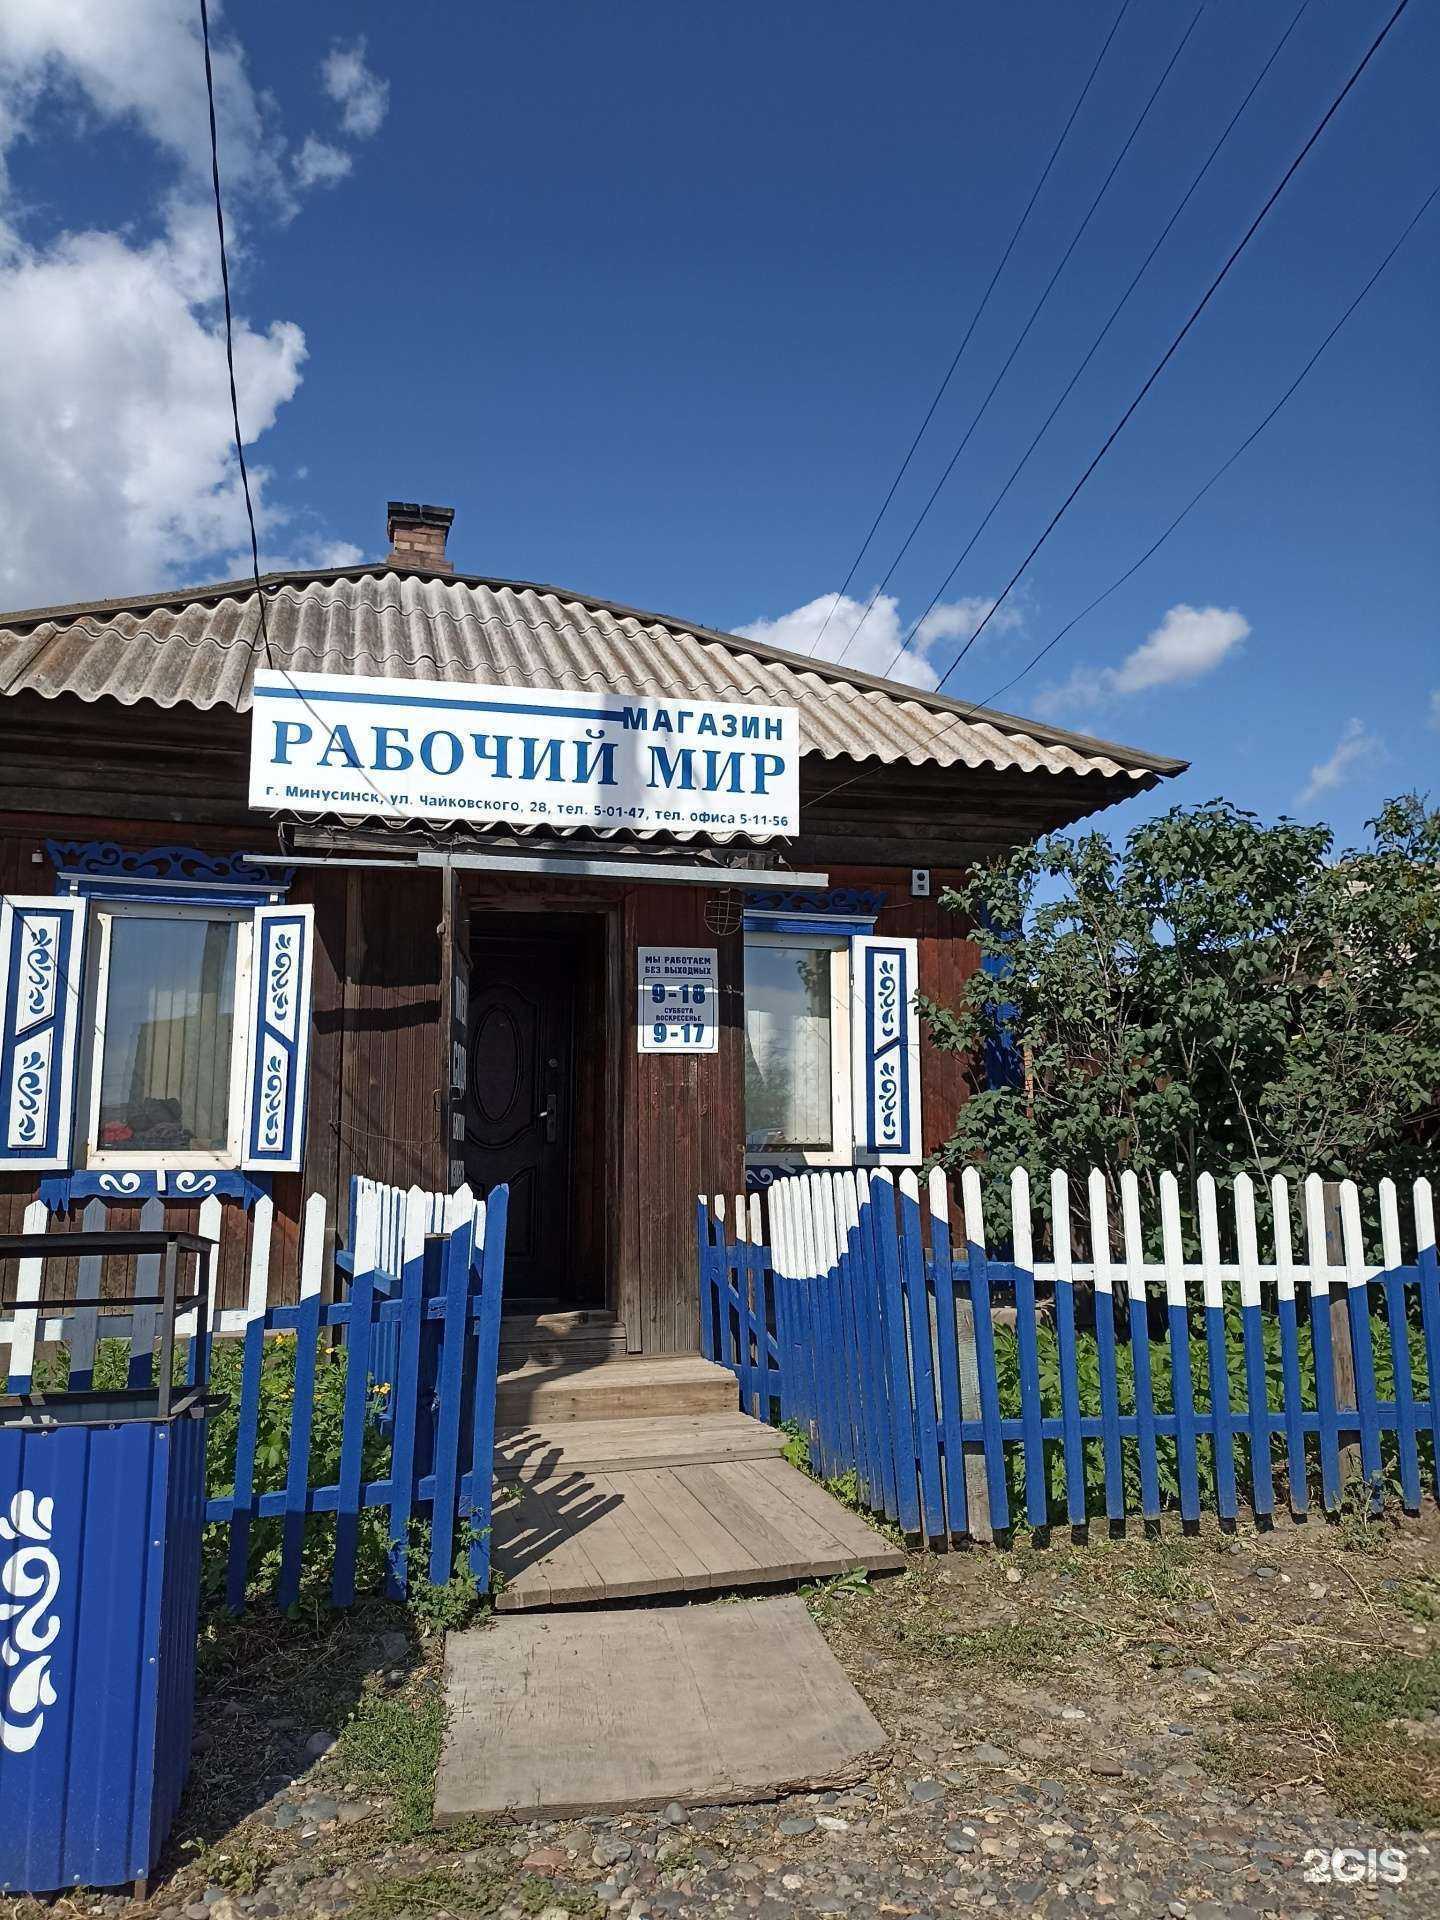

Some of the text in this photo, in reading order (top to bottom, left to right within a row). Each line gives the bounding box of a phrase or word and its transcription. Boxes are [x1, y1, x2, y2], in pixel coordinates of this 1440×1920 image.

[622, 706, 783, 741] МАГАЗИН
[270, 720, 786, 795] РАБОЧИЙ МИР
[265, 785, 789, 828] г. Минусинск, ул. Чайковского, 28, тел. 5-01-47, тел. офиса 5-11-56
[645, 956, 711, 965] МЫ РАБОТАЕМ
[645, 966, 711, 976] БЕЗ ВЫХОДНЫХ
[655, 1014, 702, 1022] ВОСКРЕСЕНЬЕ
